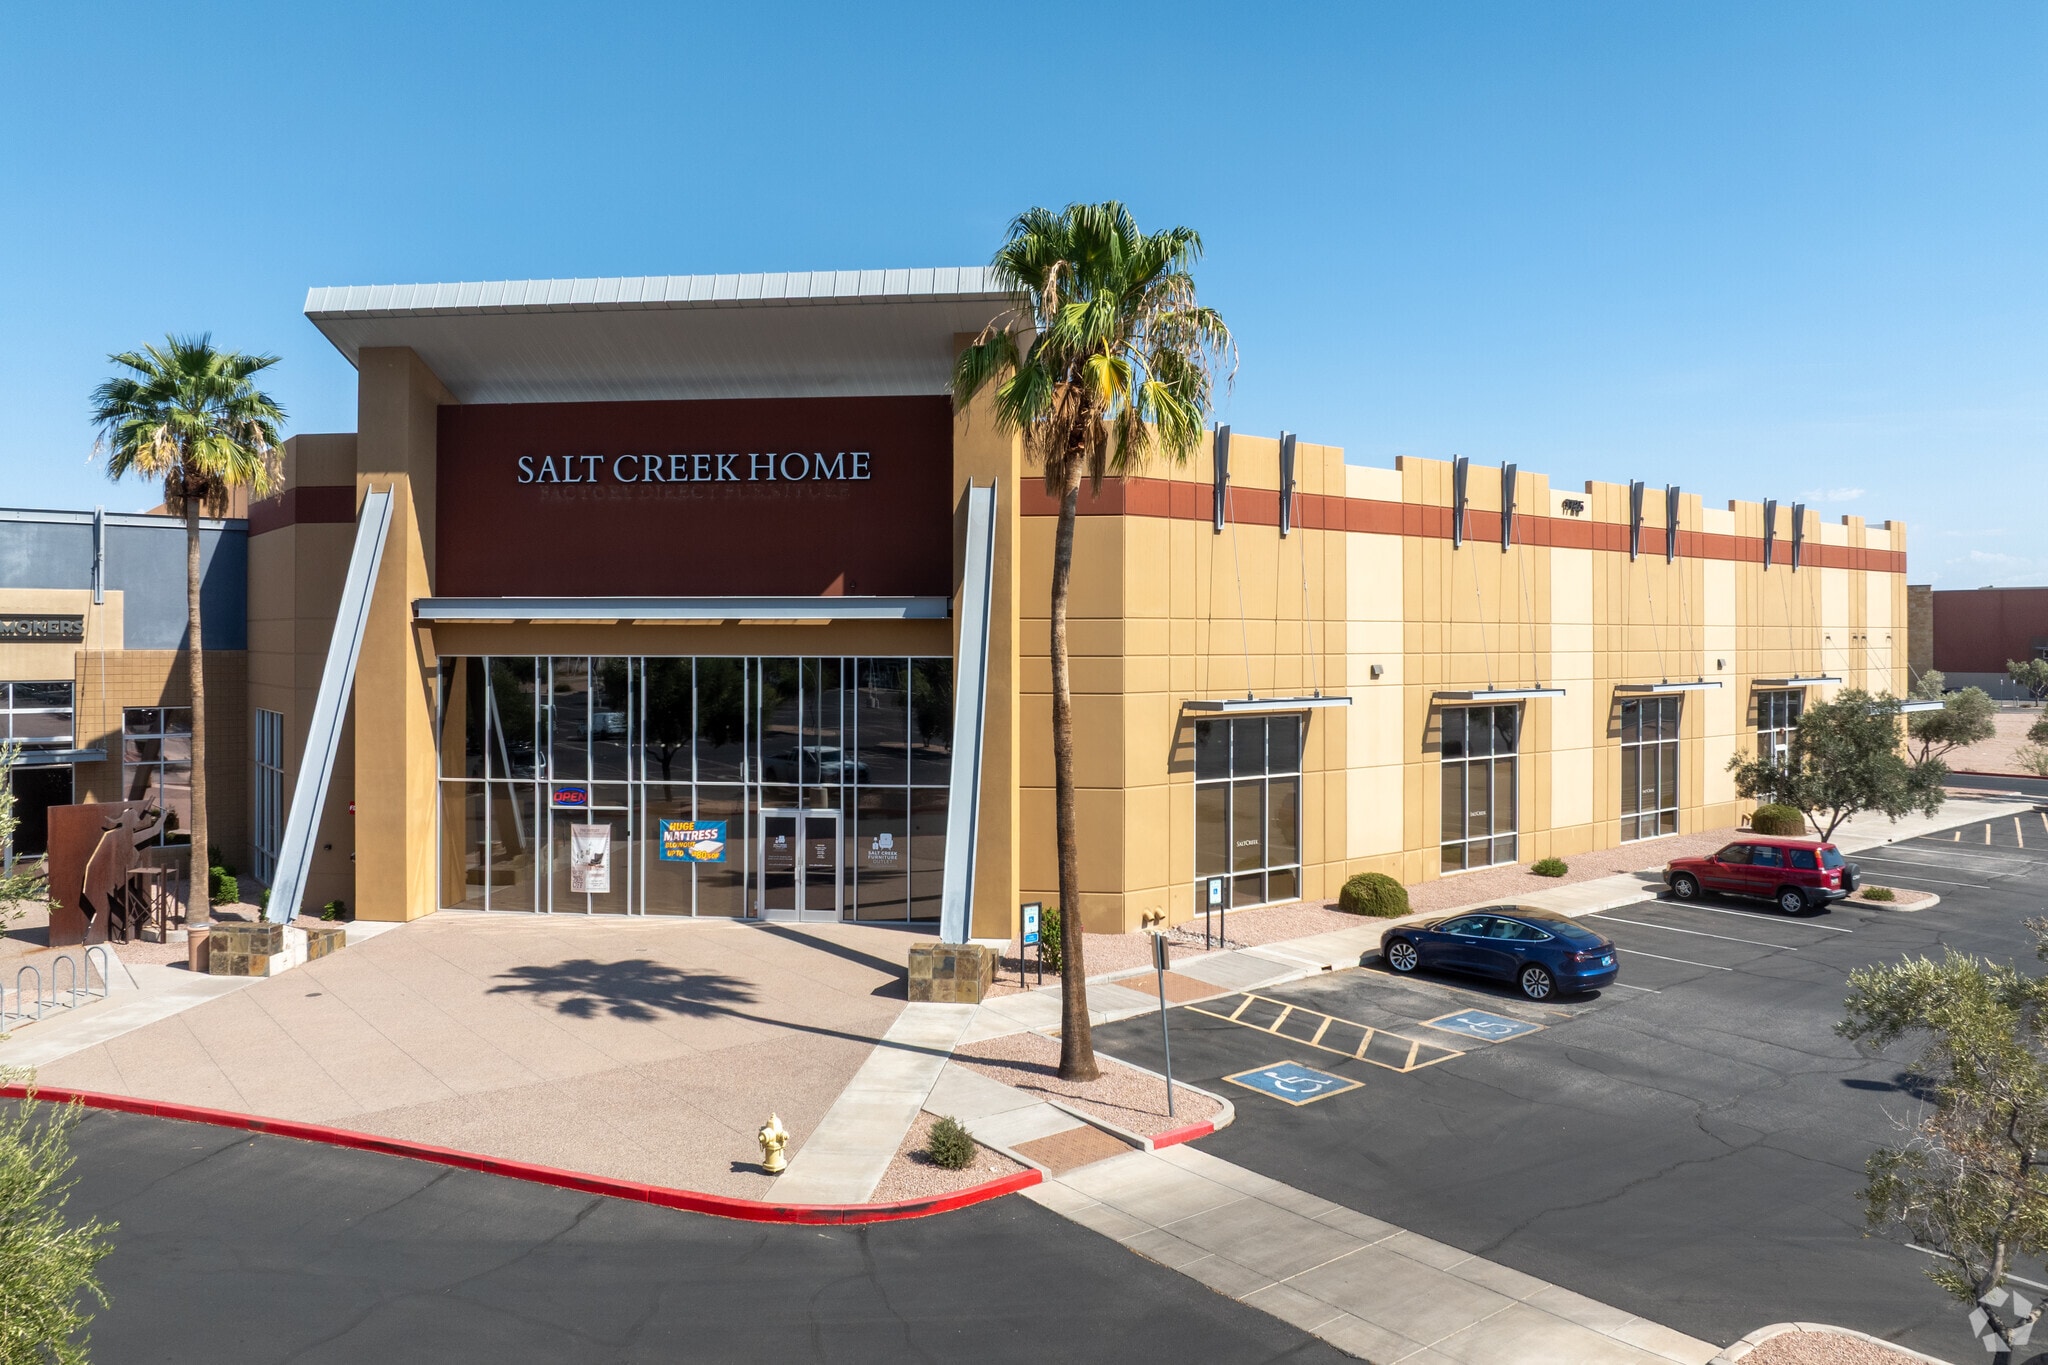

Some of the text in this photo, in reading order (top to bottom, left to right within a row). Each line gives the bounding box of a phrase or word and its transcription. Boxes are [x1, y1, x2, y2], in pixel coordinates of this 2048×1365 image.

[517, 452, 871, 483] SALT CREEK HOME
[553, 792, 587, 801] OPEN
[669, 822, 695, 831] HUGE
[663, 829, 718, 842] MATTRESS
